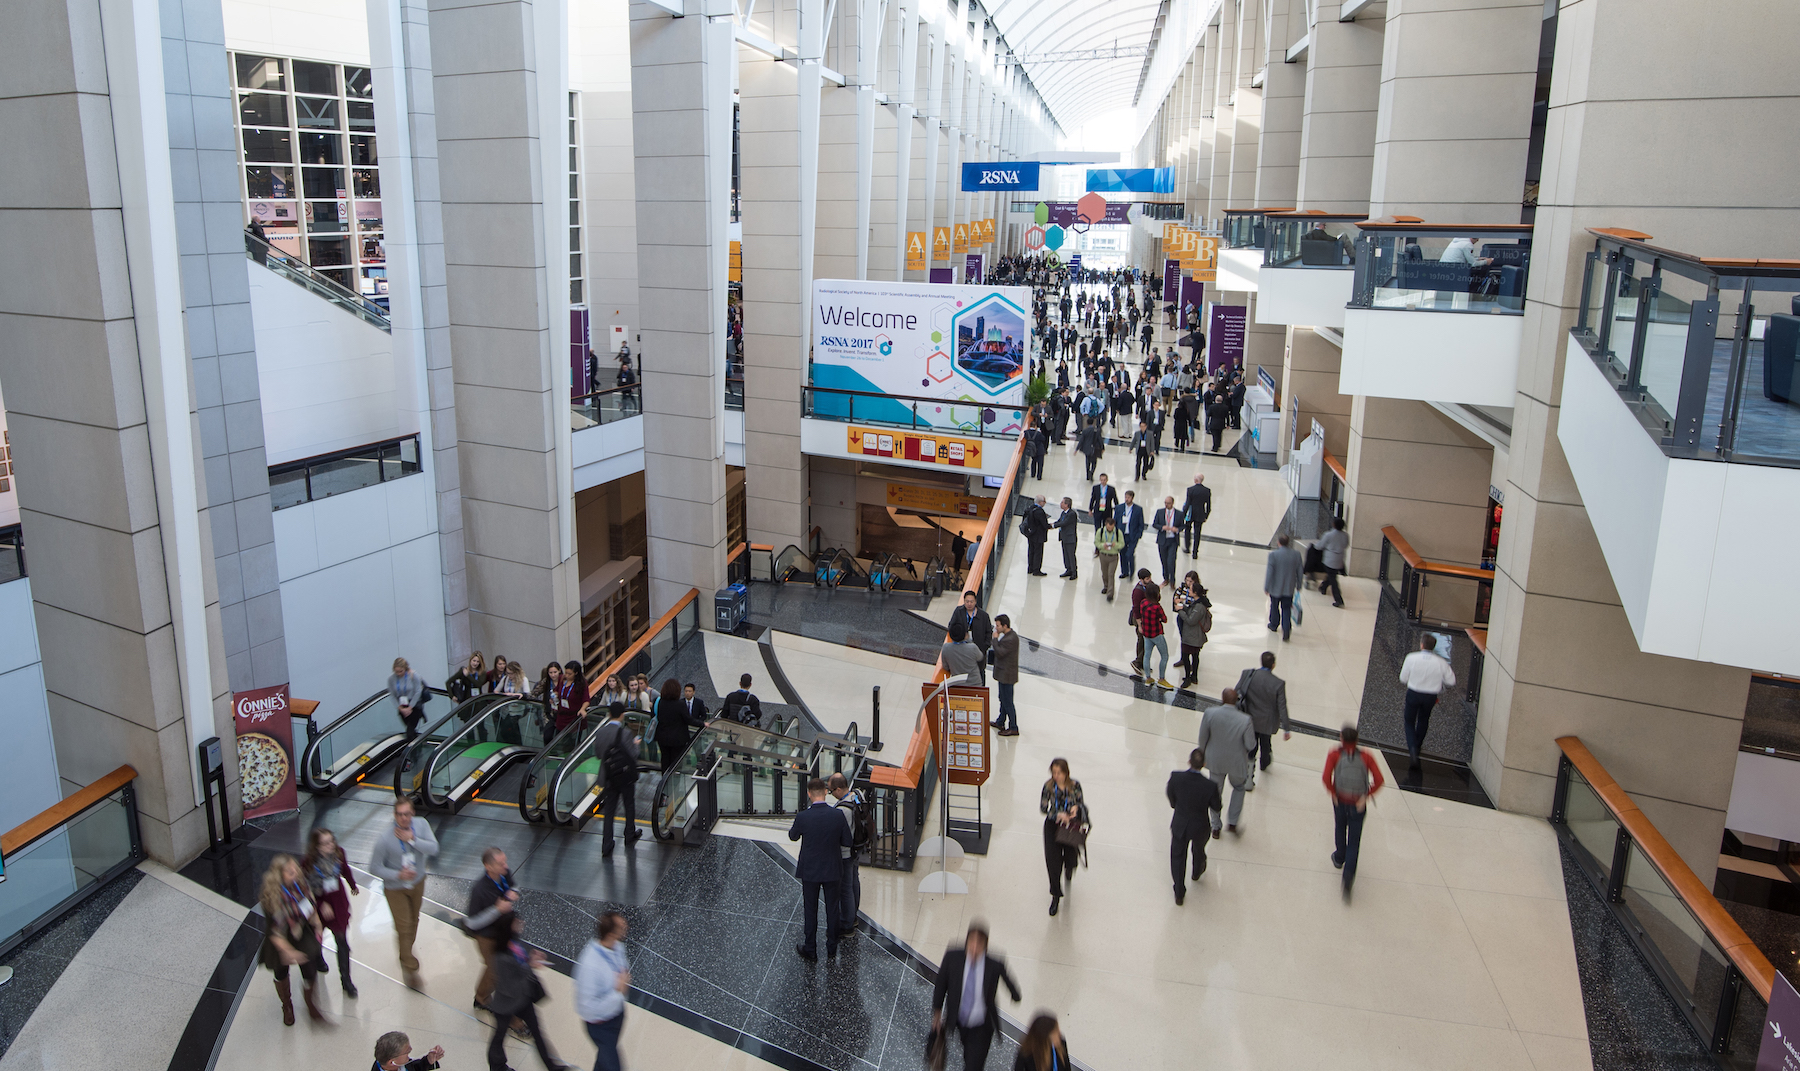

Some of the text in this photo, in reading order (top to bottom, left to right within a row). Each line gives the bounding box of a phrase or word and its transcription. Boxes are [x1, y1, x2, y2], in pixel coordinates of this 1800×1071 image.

[954, 225, 967, 240] A
[971, 222, 982, 235] A
[983, 220, 994, 232] A
[908, 234, 924, 252] A
[934, 229, 949, 245] A
[1196, 239, 1214, 261] B
[820, 305, 917, 330] Welcome
[820, 336, 873, 349] RSNA 2017
[237, 693, 285, 718] CONNIE'S
[251, 711, 275, 723] pizza
